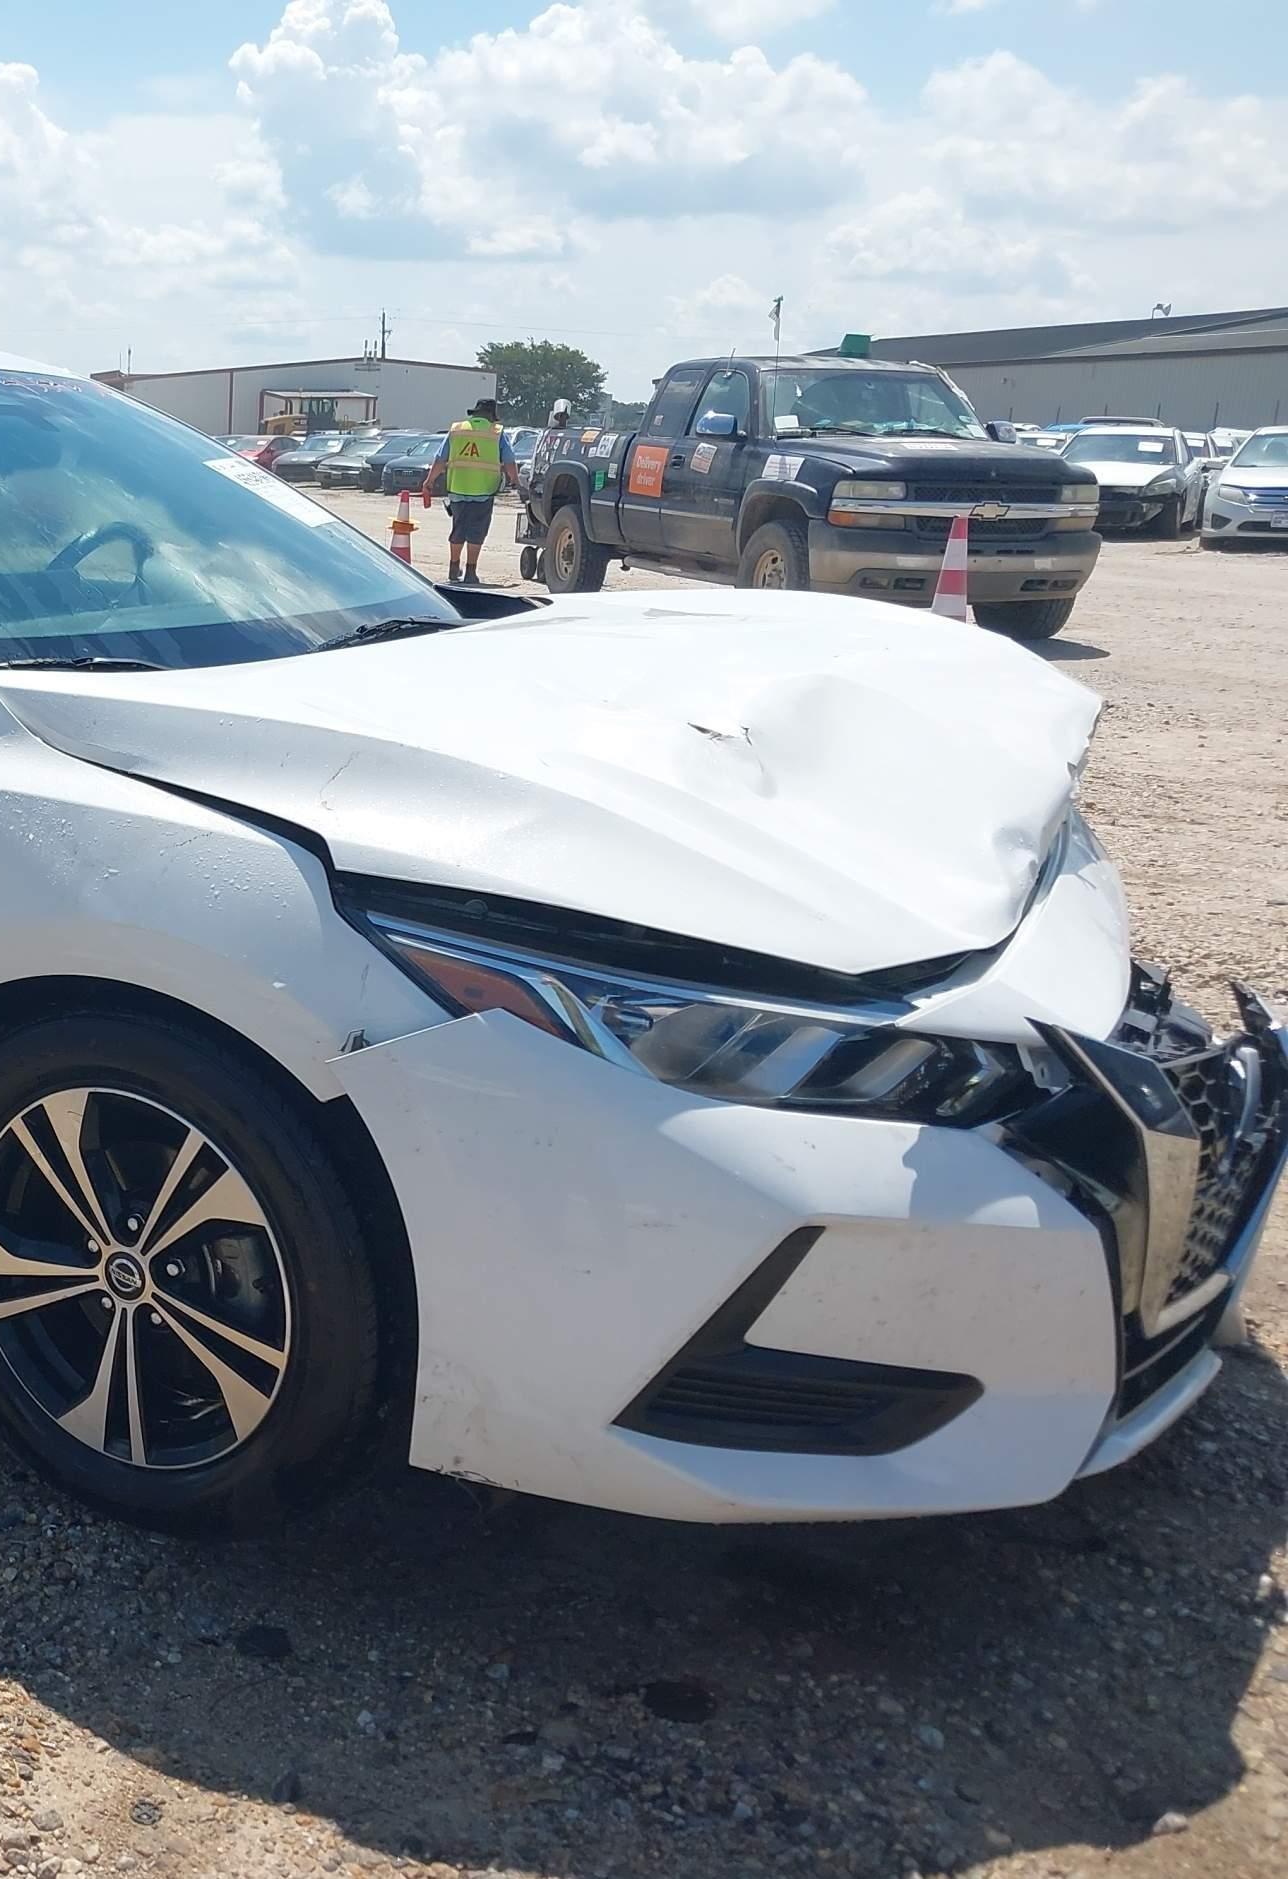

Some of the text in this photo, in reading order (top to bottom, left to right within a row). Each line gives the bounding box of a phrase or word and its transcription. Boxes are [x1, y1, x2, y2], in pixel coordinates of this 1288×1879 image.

[635, 455, 662, 472] Delivery
[636, 472, 656, 487] driver
[112, 1269, 139, 1286] NISSAN
